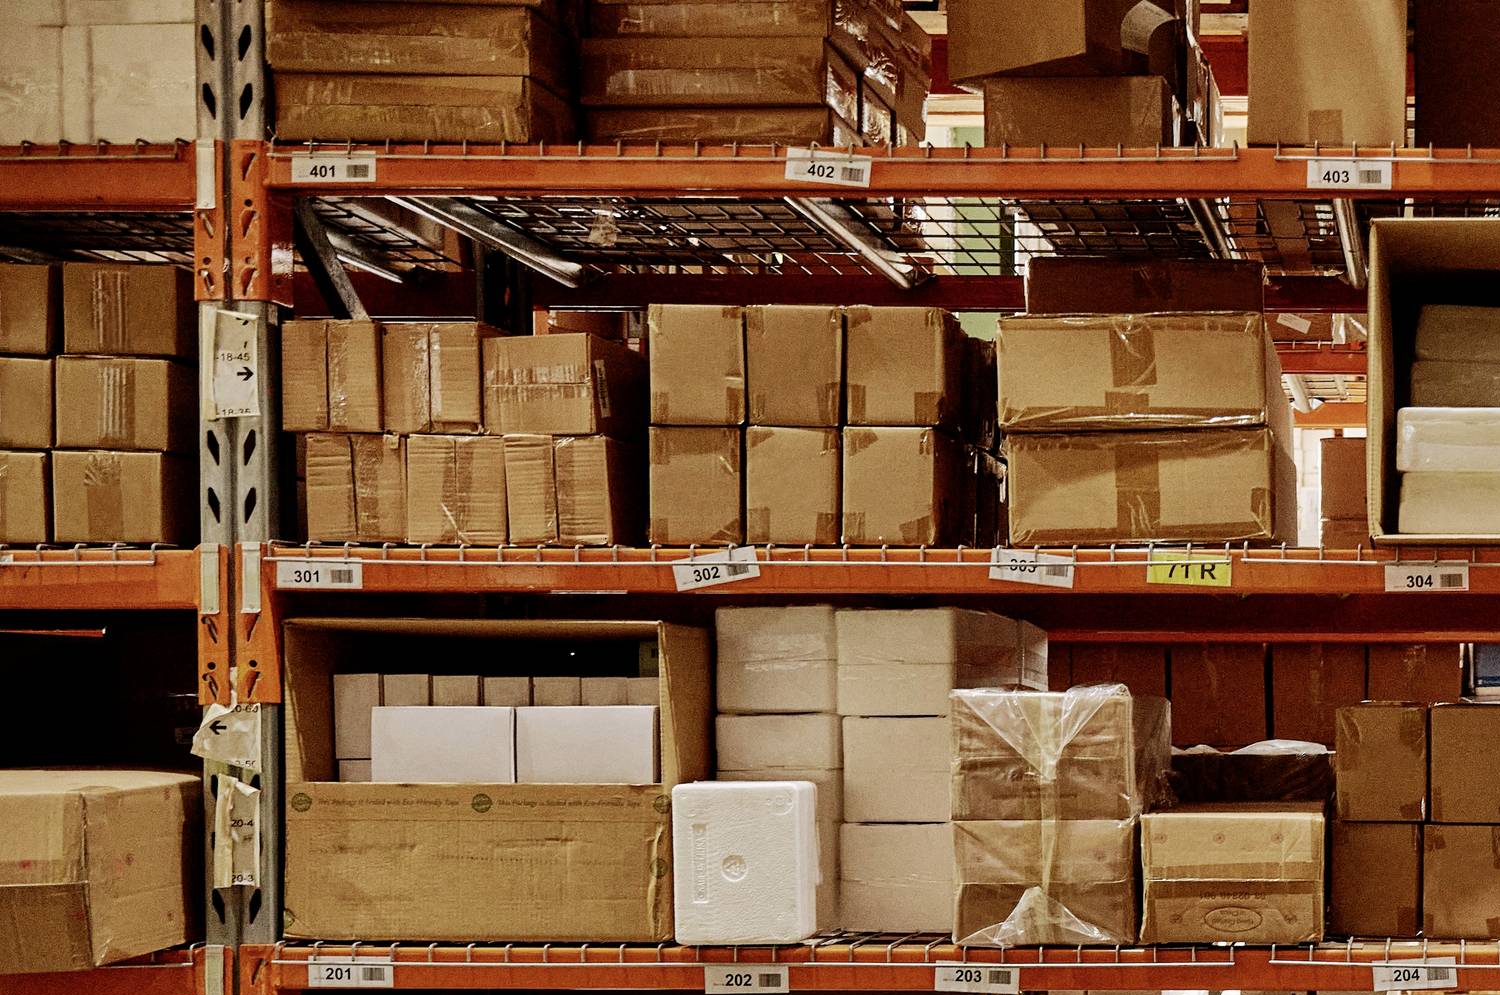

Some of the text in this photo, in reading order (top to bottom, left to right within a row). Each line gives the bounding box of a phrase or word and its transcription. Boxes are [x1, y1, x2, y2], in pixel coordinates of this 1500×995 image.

[309, 164, 336, 178] 401
[807, 164, 835, 179] 402
[1322, 170, 1350, 184] 403
[1009, 558, 1037, 573] 303
[294, 569, 320, 583] 301
[693, 566, 720, 582] 302
[1406, 574, 1433, 589] 304
[325, 967, 352, 981] 201
[725, 973, 753, 987] 202
[955, 969, 982, 983] 203
[1393, 967, 1420, 982] 204
